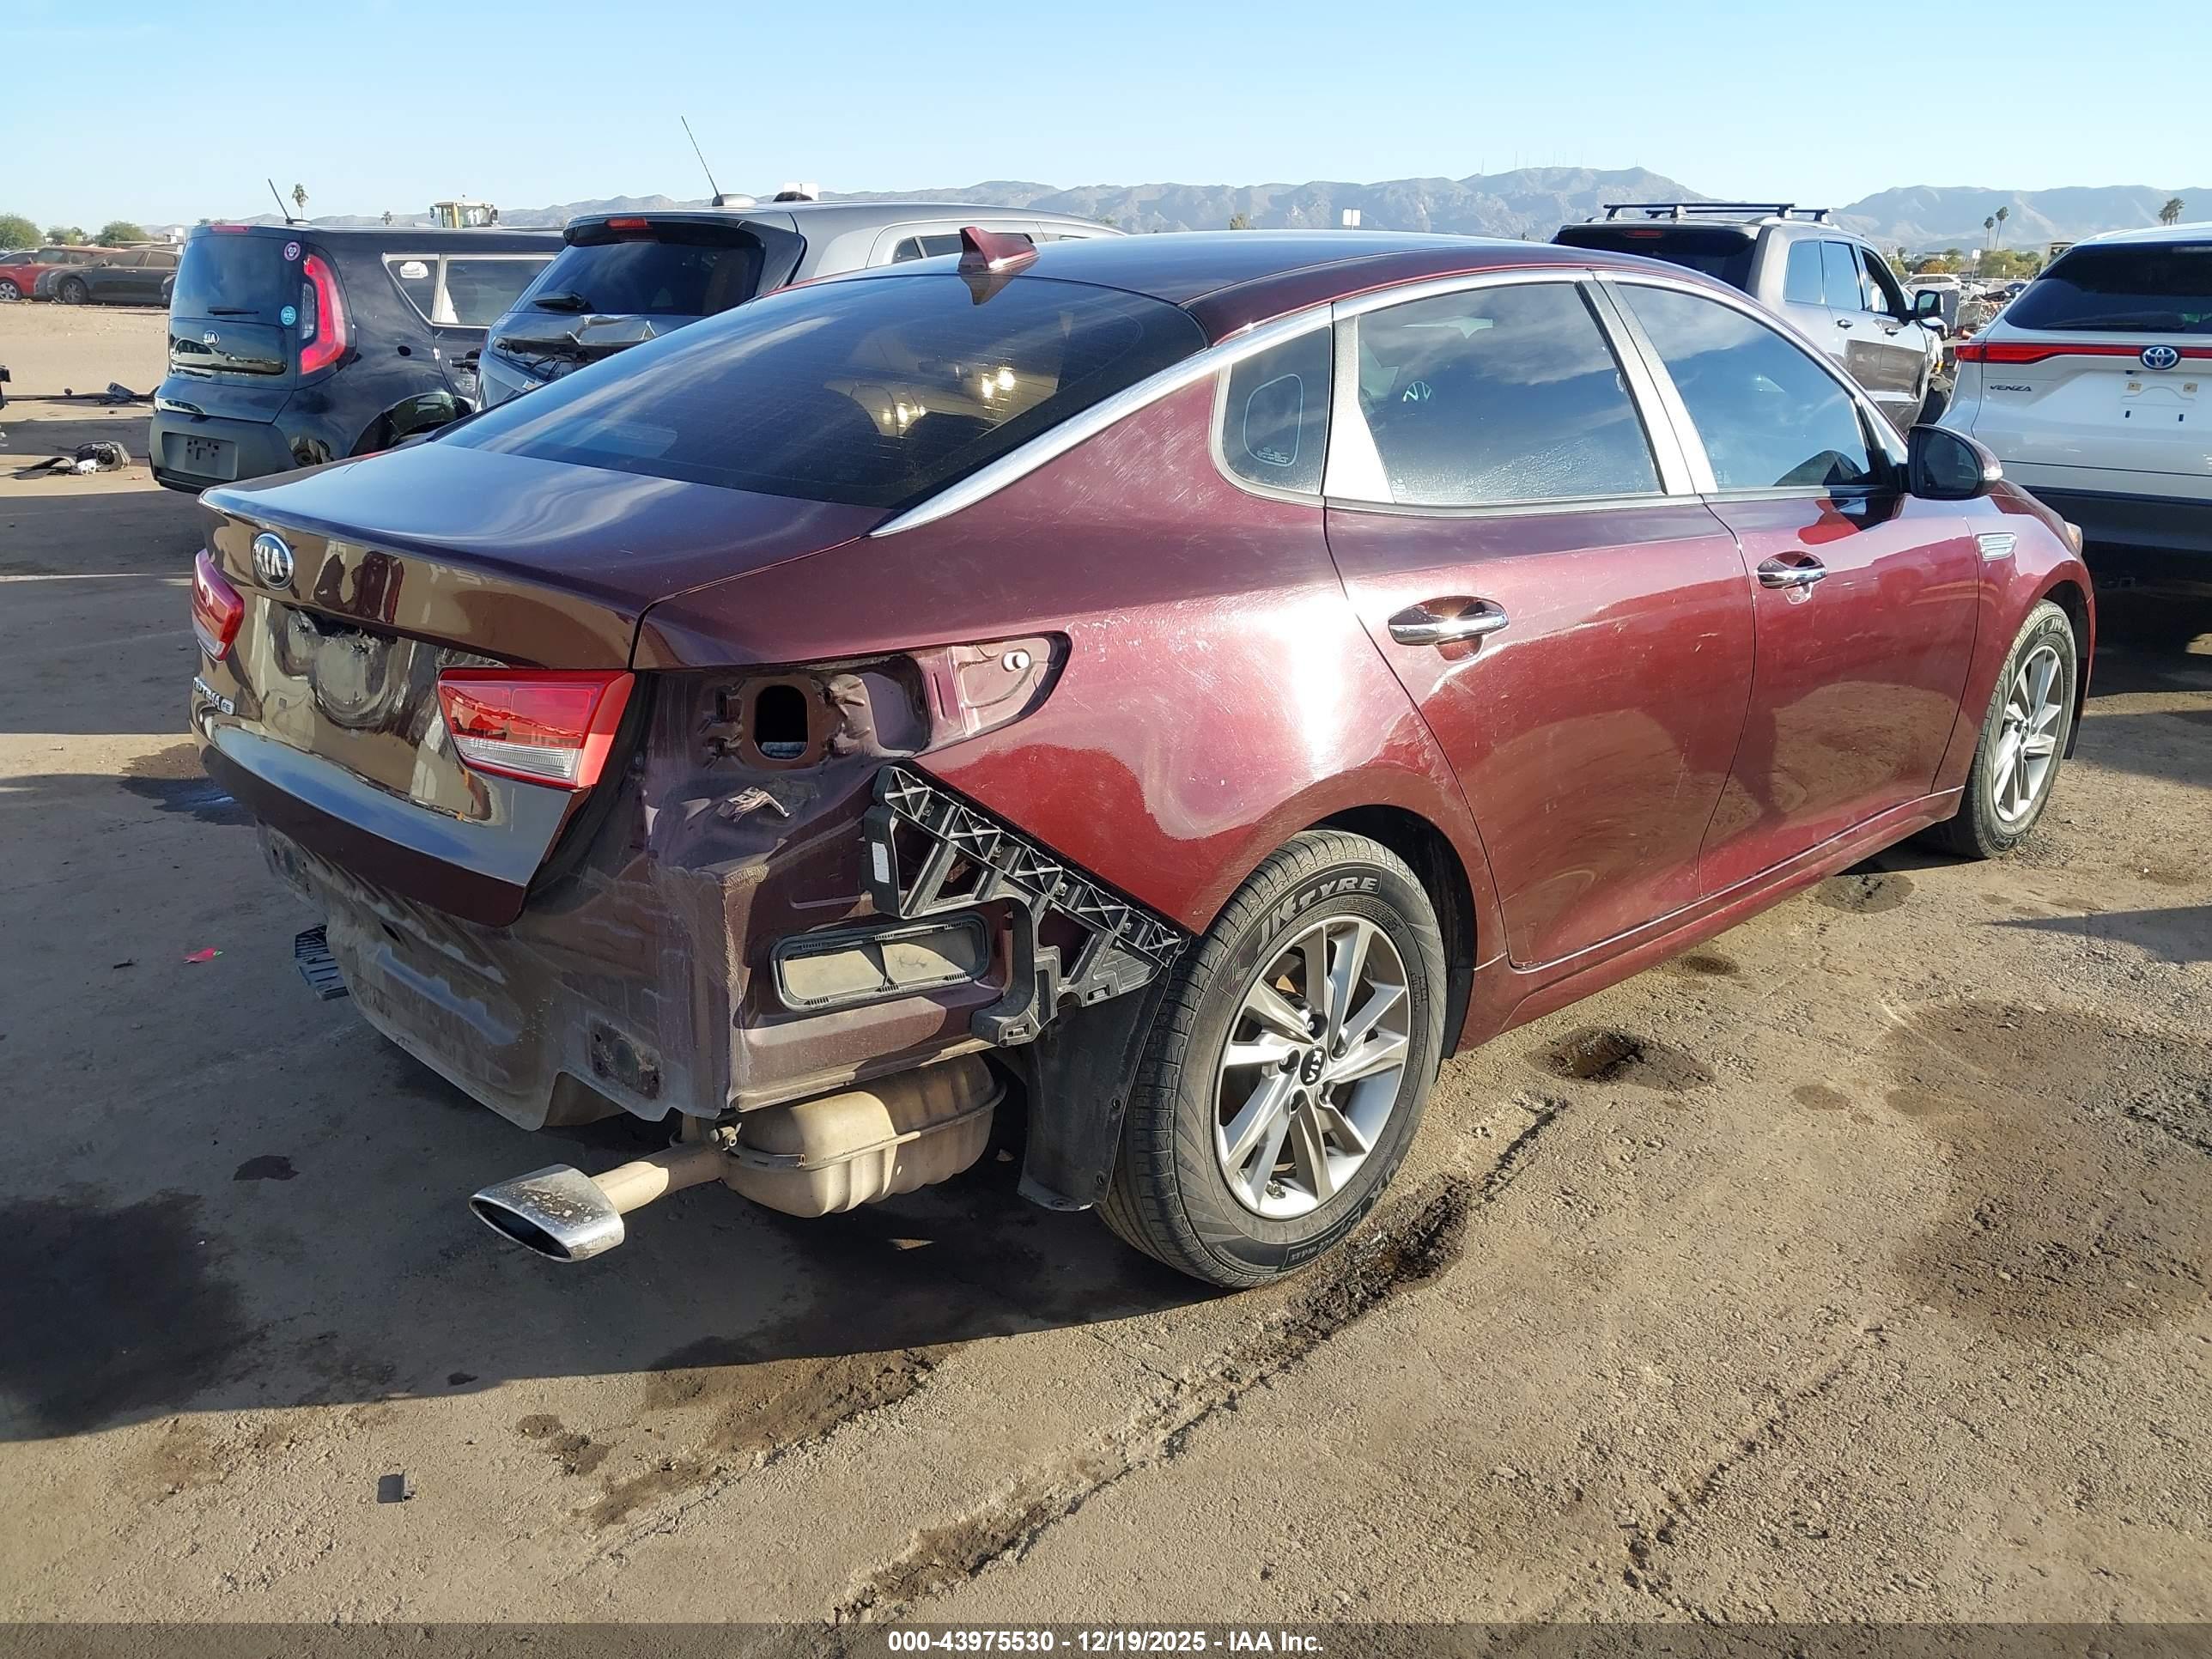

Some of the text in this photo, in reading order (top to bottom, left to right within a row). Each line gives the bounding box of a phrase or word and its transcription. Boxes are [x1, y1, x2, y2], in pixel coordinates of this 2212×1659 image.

[1989, 384, 2033, 392] VENZA
[252, 543, 285, 578] KIA
[1304, 1049, 1323, 1083] KIA
